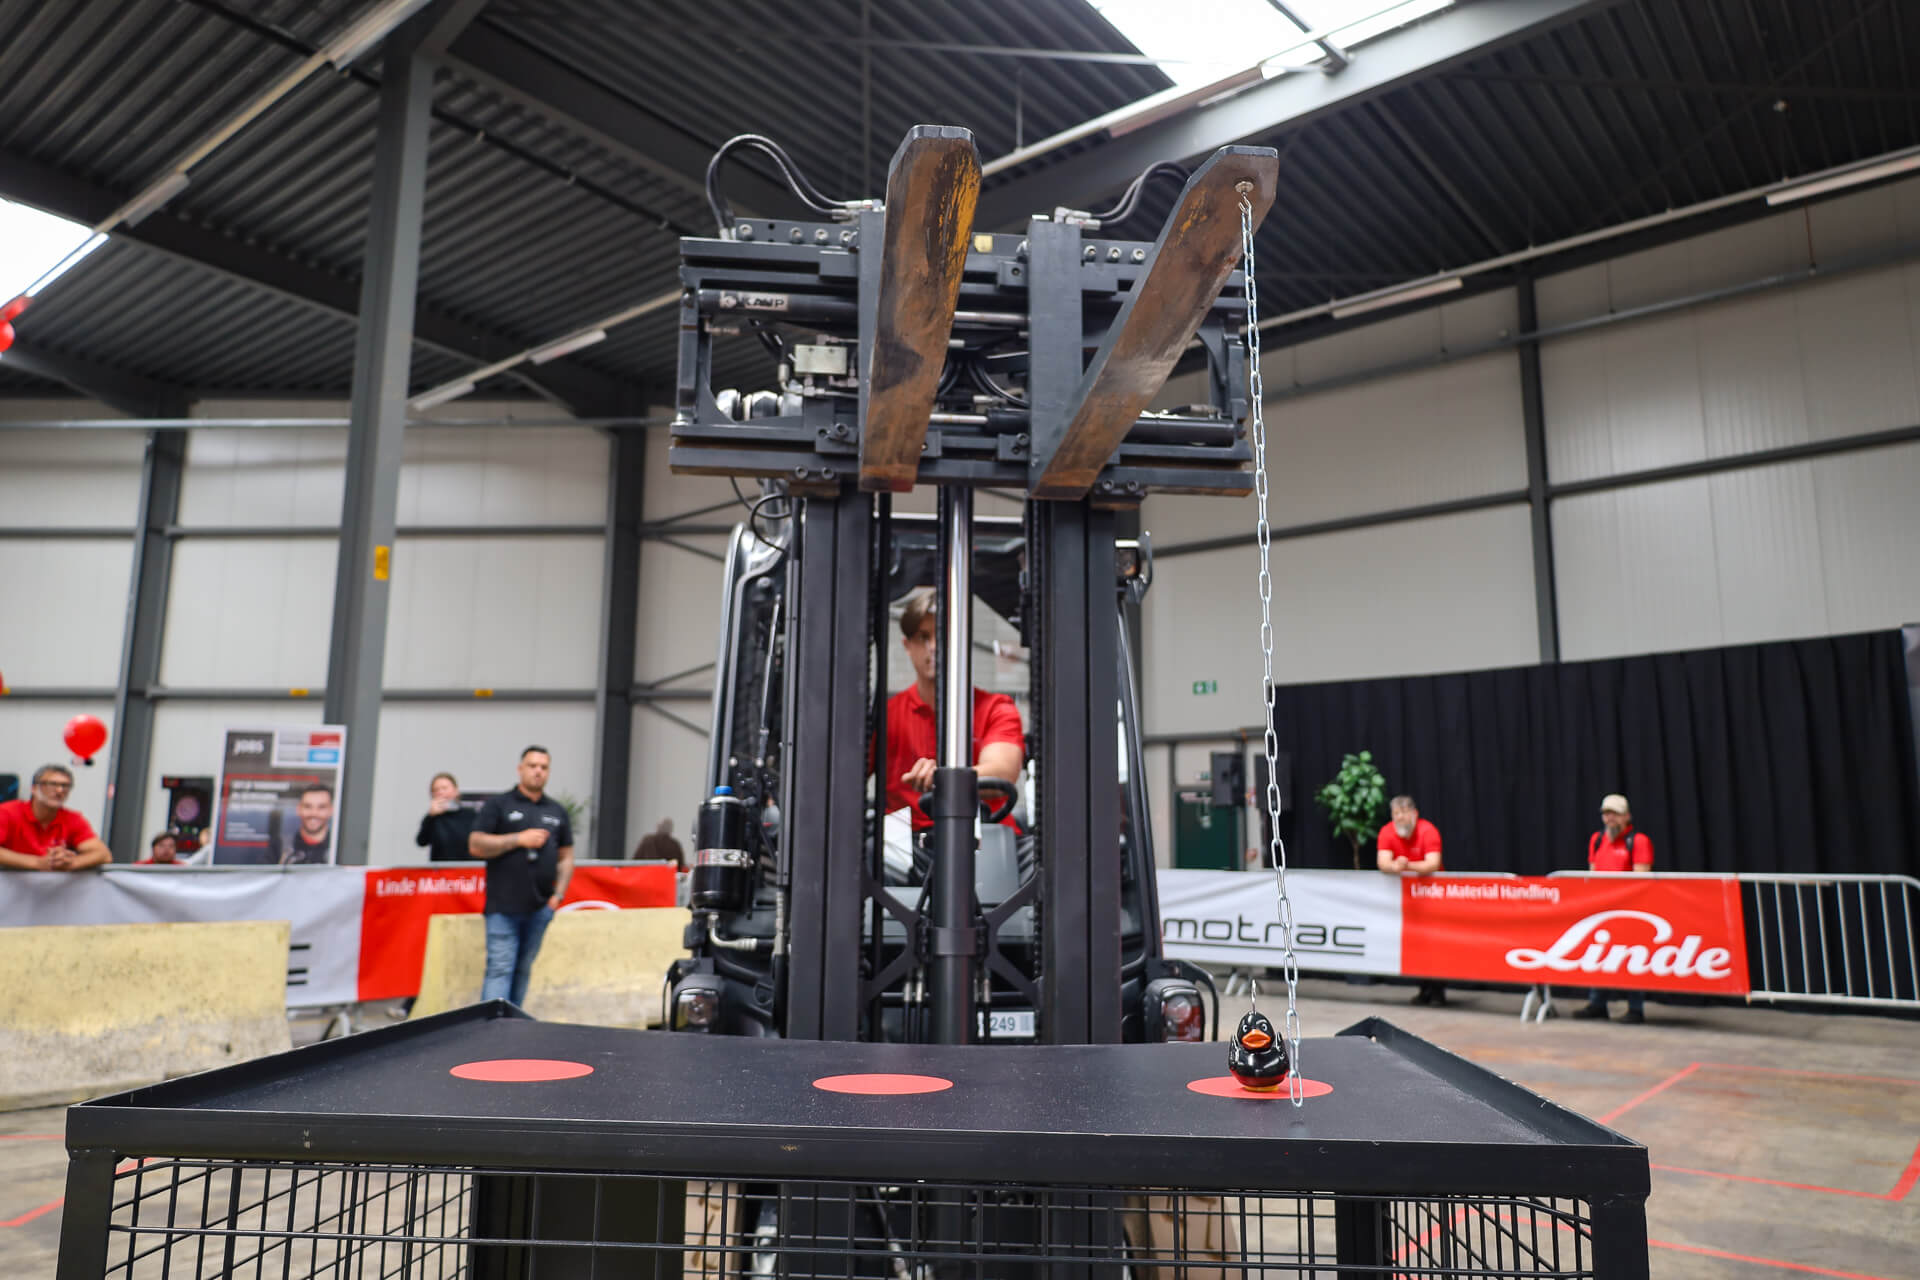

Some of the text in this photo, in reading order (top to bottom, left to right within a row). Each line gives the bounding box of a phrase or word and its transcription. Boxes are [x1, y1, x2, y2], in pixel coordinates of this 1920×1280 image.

[376, 878, 416, 898] Linde
[418, 876, 477, 895] Material
[1411, 883, 1560, 904] Linde Material Handling
[1163, 914, 1366, 948] motrac
[1504, 909, 1731, 979] Linde
